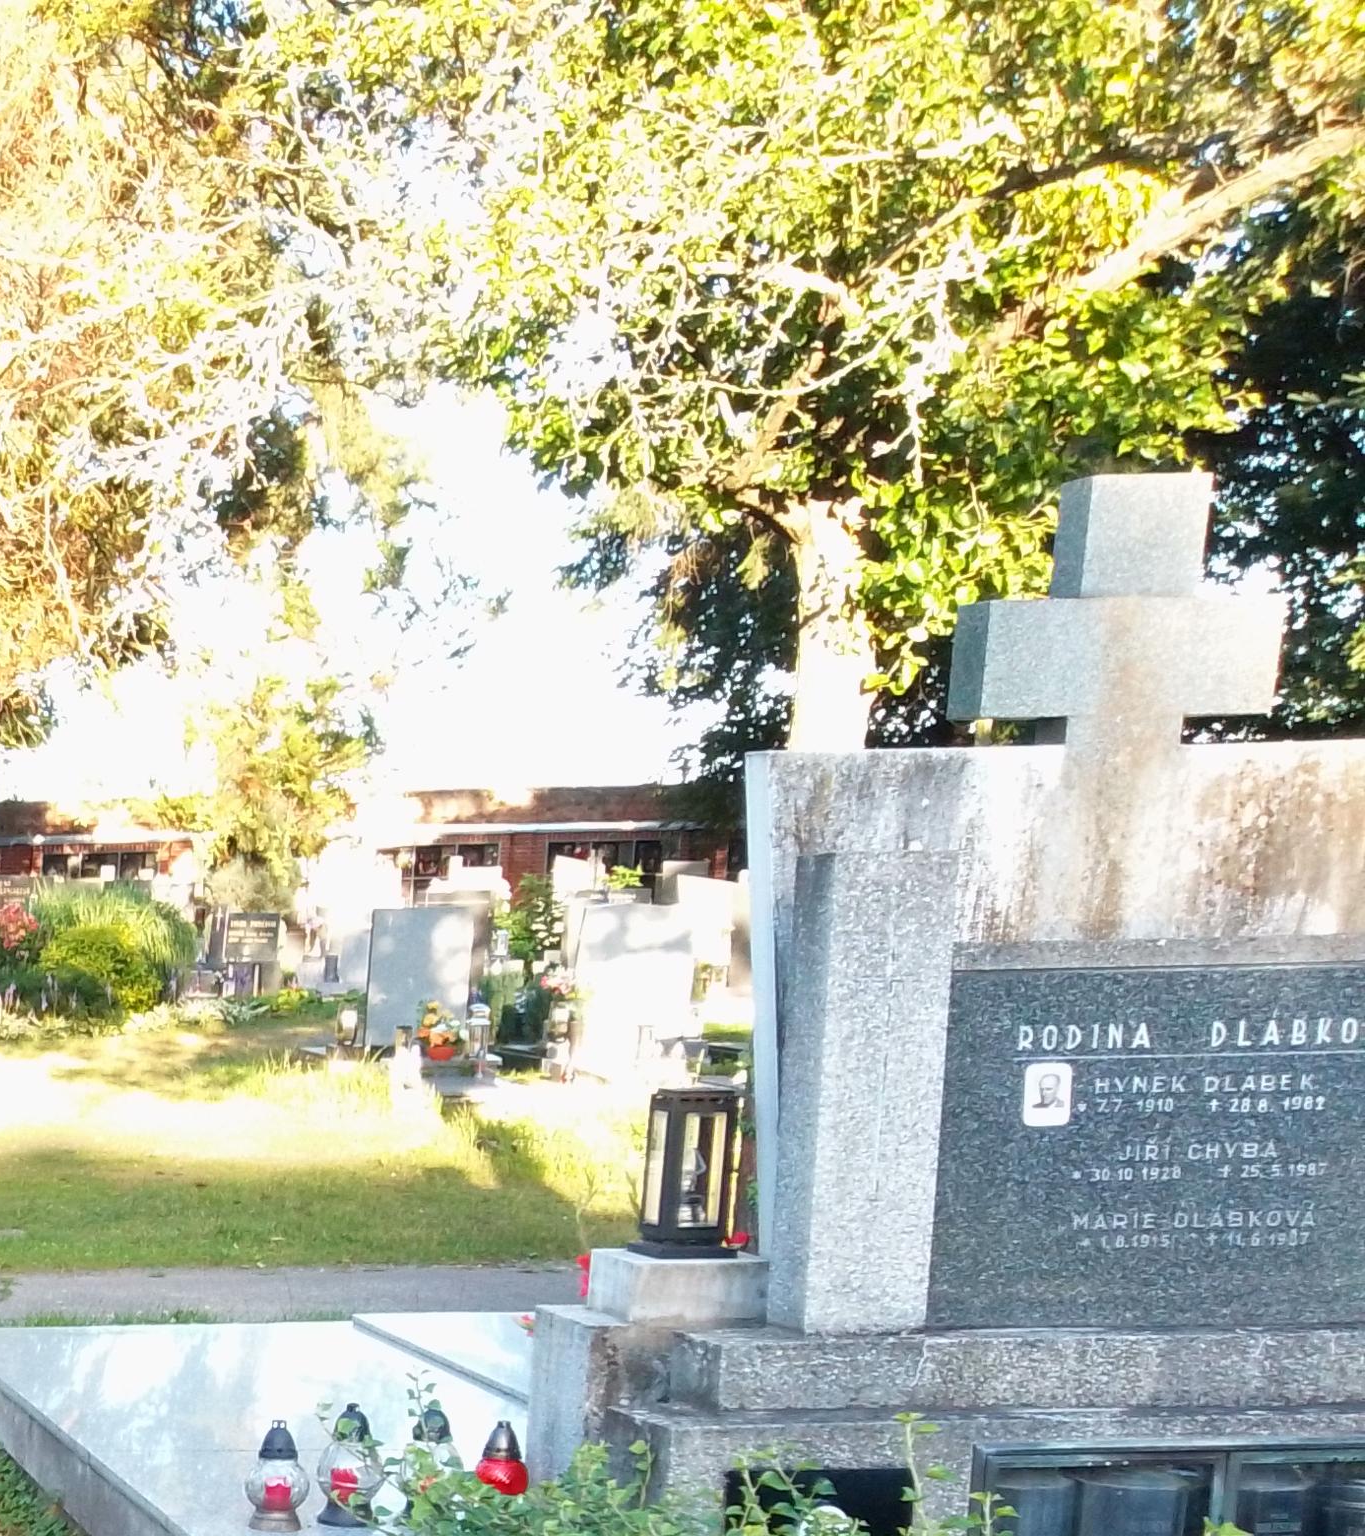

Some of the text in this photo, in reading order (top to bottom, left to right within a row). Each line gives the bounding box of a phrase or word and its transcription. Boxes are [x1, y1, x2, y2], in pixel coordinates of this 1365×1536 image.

[1018, 1008, 1365, 1051] RODINA DLÁBKO
[1094, 1075, 1187, 1095] HYNEK
[1119, 1136, 1171, 1161] JIŘÍ
[1071, 1210, 1157, 1230] MARIE
